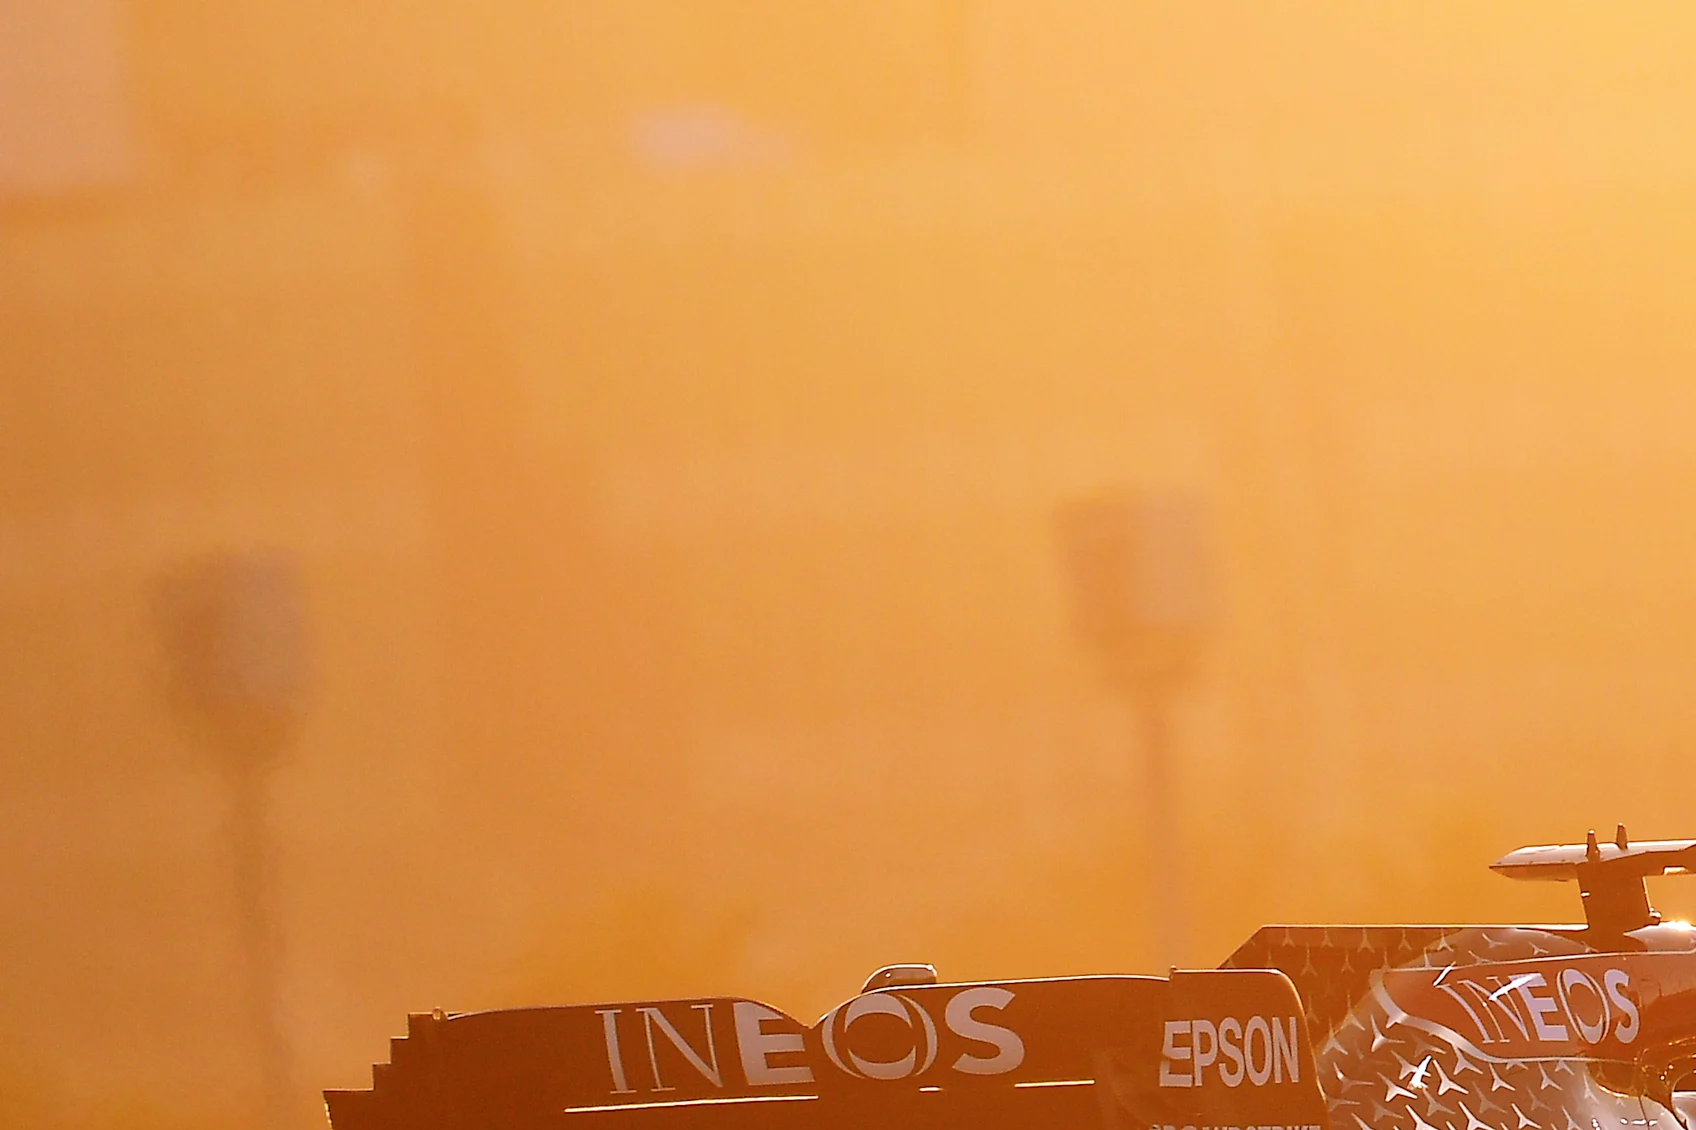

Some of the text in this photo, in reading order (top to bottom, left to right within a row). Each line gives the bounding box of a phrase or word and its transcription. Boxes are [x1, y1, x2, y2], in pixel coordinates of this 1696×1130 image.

[595, 987, 1025, 1093] INEOS
[1435, 968, 1640, 1044] INEOS
[1159, 1016, 1300, 1087] EPSON
